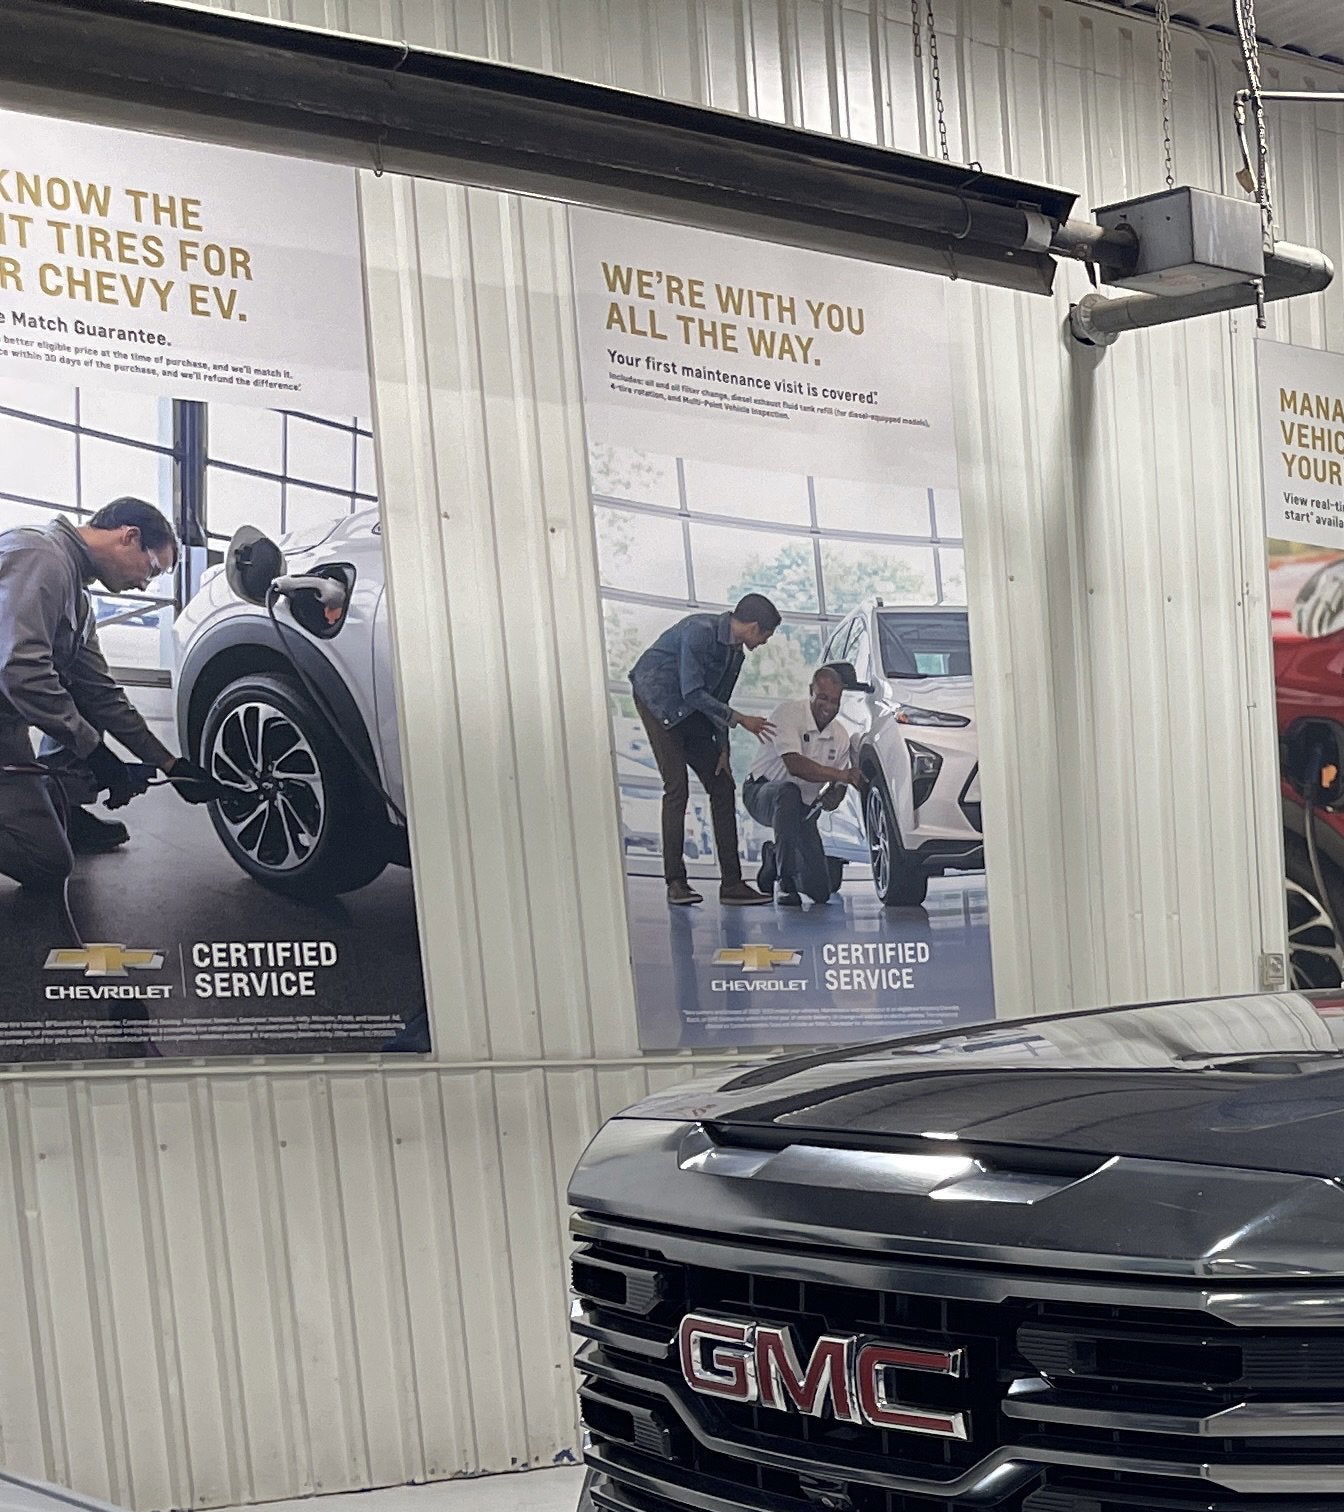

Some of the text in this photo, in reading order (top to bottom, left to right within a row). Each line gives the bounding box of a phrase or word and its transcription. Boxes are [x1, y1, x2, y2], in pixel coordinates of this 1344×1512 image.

[125, 189, 203, 231] THE
[47, 219, 165, 269] TIRES
[178, 240, 254, 281] FOR
[39, 262, 174, 312] CHEVY
[189, 283, 248, 322] EV.
[601, 262, 865, 335] WE’RE WITH YOU
[11, 311, 68, 333] Match
[74, 320, 172, 347] Guarantee.
[605, 302, 822, 366] ALL THE WAY.
[38, 341, 71, 353] eligible
[75, 346, 98, 357] price
[113, 351, 128, 360] the
[131, 353, 151, 362] time
[59, 356, 81, 367] days
[96, 360, 111, 369] the
[236, 377, 250, 386] the
[607, 349, 641, 369] Your
[645, 356, 678, 375] first
[681, 364, 771, 391] maintenance
[774, 378, 803, 396] visit
[806, 382, 818, 398] is
[1281, 452, 1342, 487] YOUR
[1283, 492, 1308, 507] View
[192, 941, 338, 968] CERTIFIED
[822, 942, 930, 966] CERTIFIED
[45, 984, 173, 1000] CHEVROLET
[194, 971, 316, 999] SERVICE
[711, 979, 809, 992] CHEVROLET
[824, 967, 915, 991] SERVICE
[679, 1312, 969, 1441] GMC
